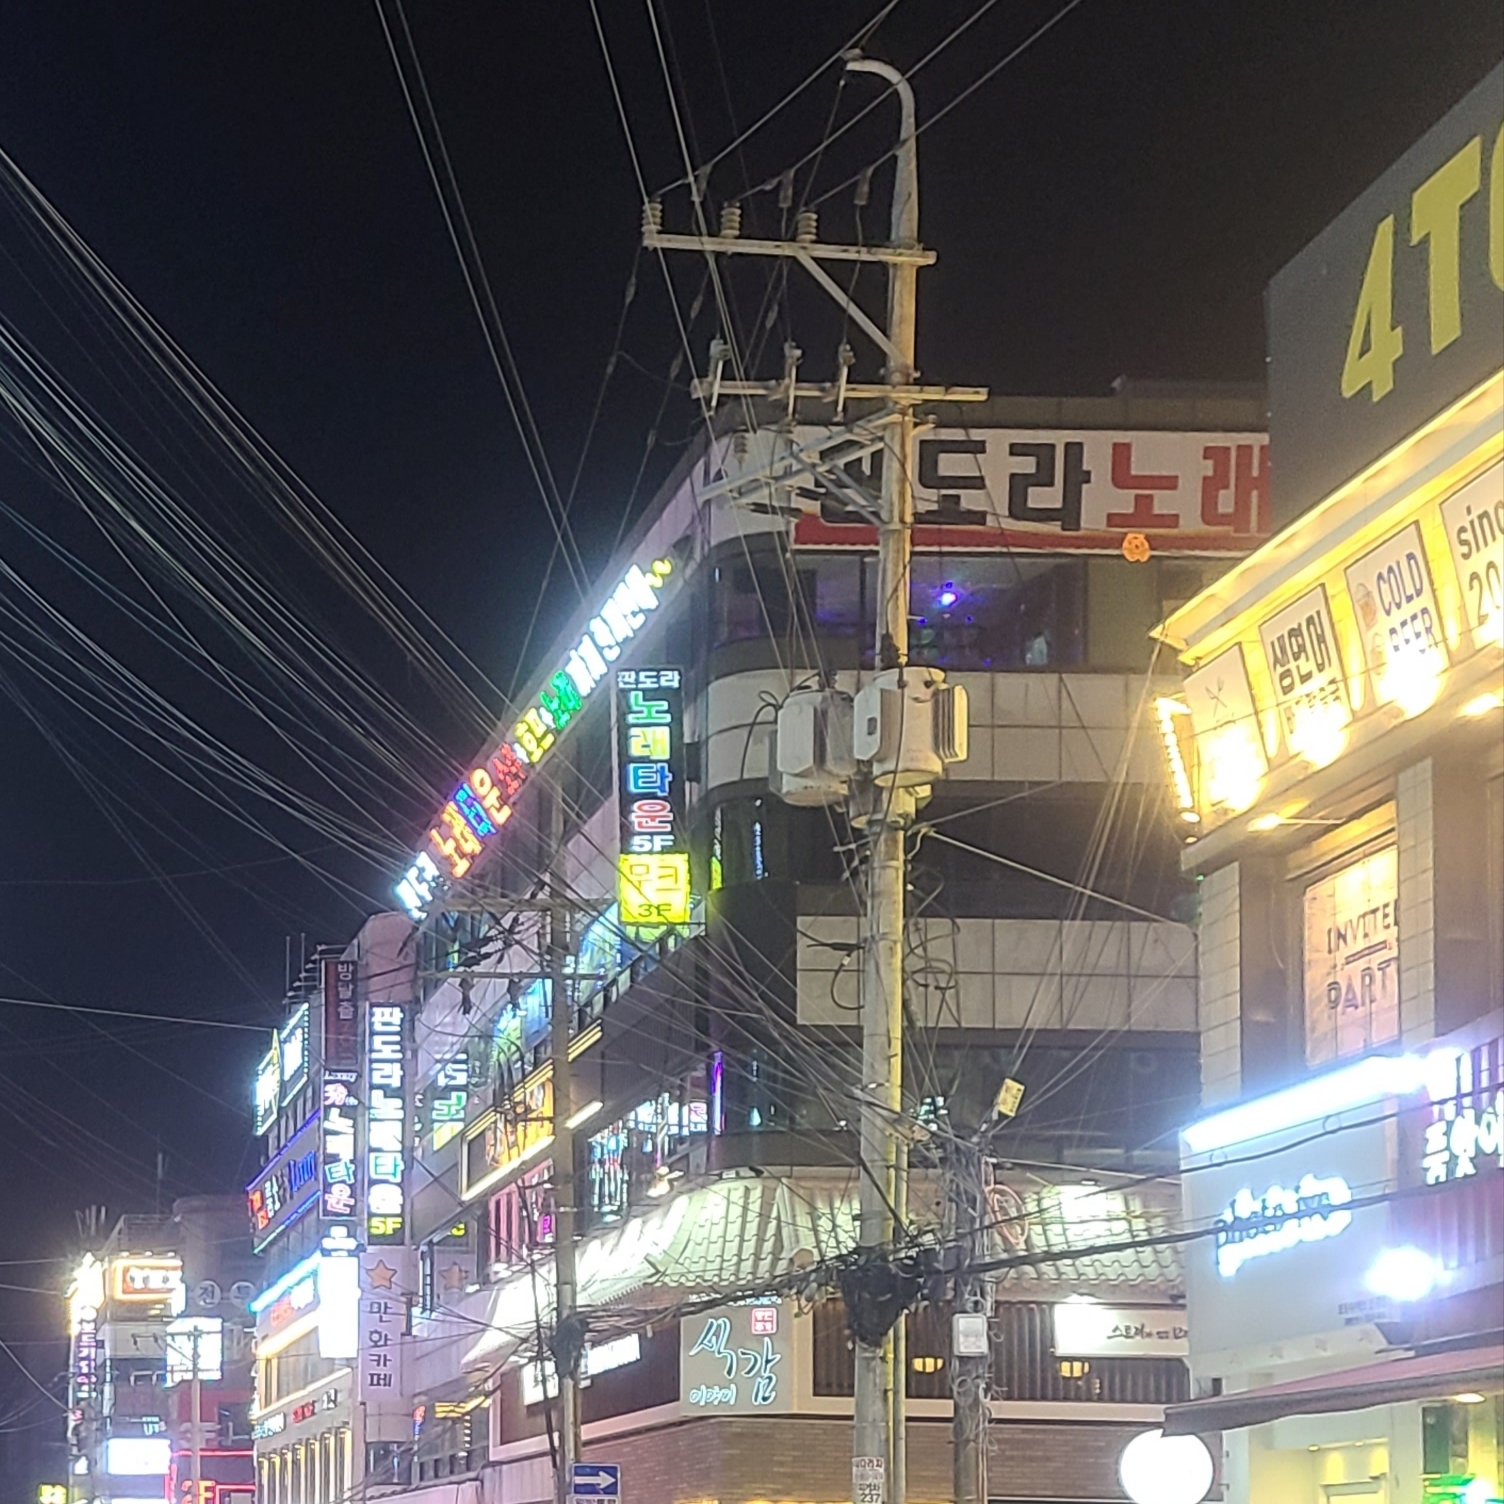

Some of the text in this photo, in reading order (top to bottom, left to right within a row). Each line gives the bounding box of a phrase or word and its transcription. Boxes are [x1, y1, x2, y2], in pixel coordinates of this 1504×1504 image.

[1340, 118, 1504, 402] 4T
[1376, 552, 1424, 617] COLD
[1389, 606, 1440, 655] BEER
[617, 670, 681, 689] 판도라
[625, 691, 675, 833] 노래타운
[632, 836, 675, 854] 5F
[638, 903, 673, 918] 3F
[1327, 900, 1398, 955] INVITE
[369, 1216, 403, 1235] 5F
[367, 1302, 393, 1388] 만화카페
[860, 1492, 881, 1503] 237
